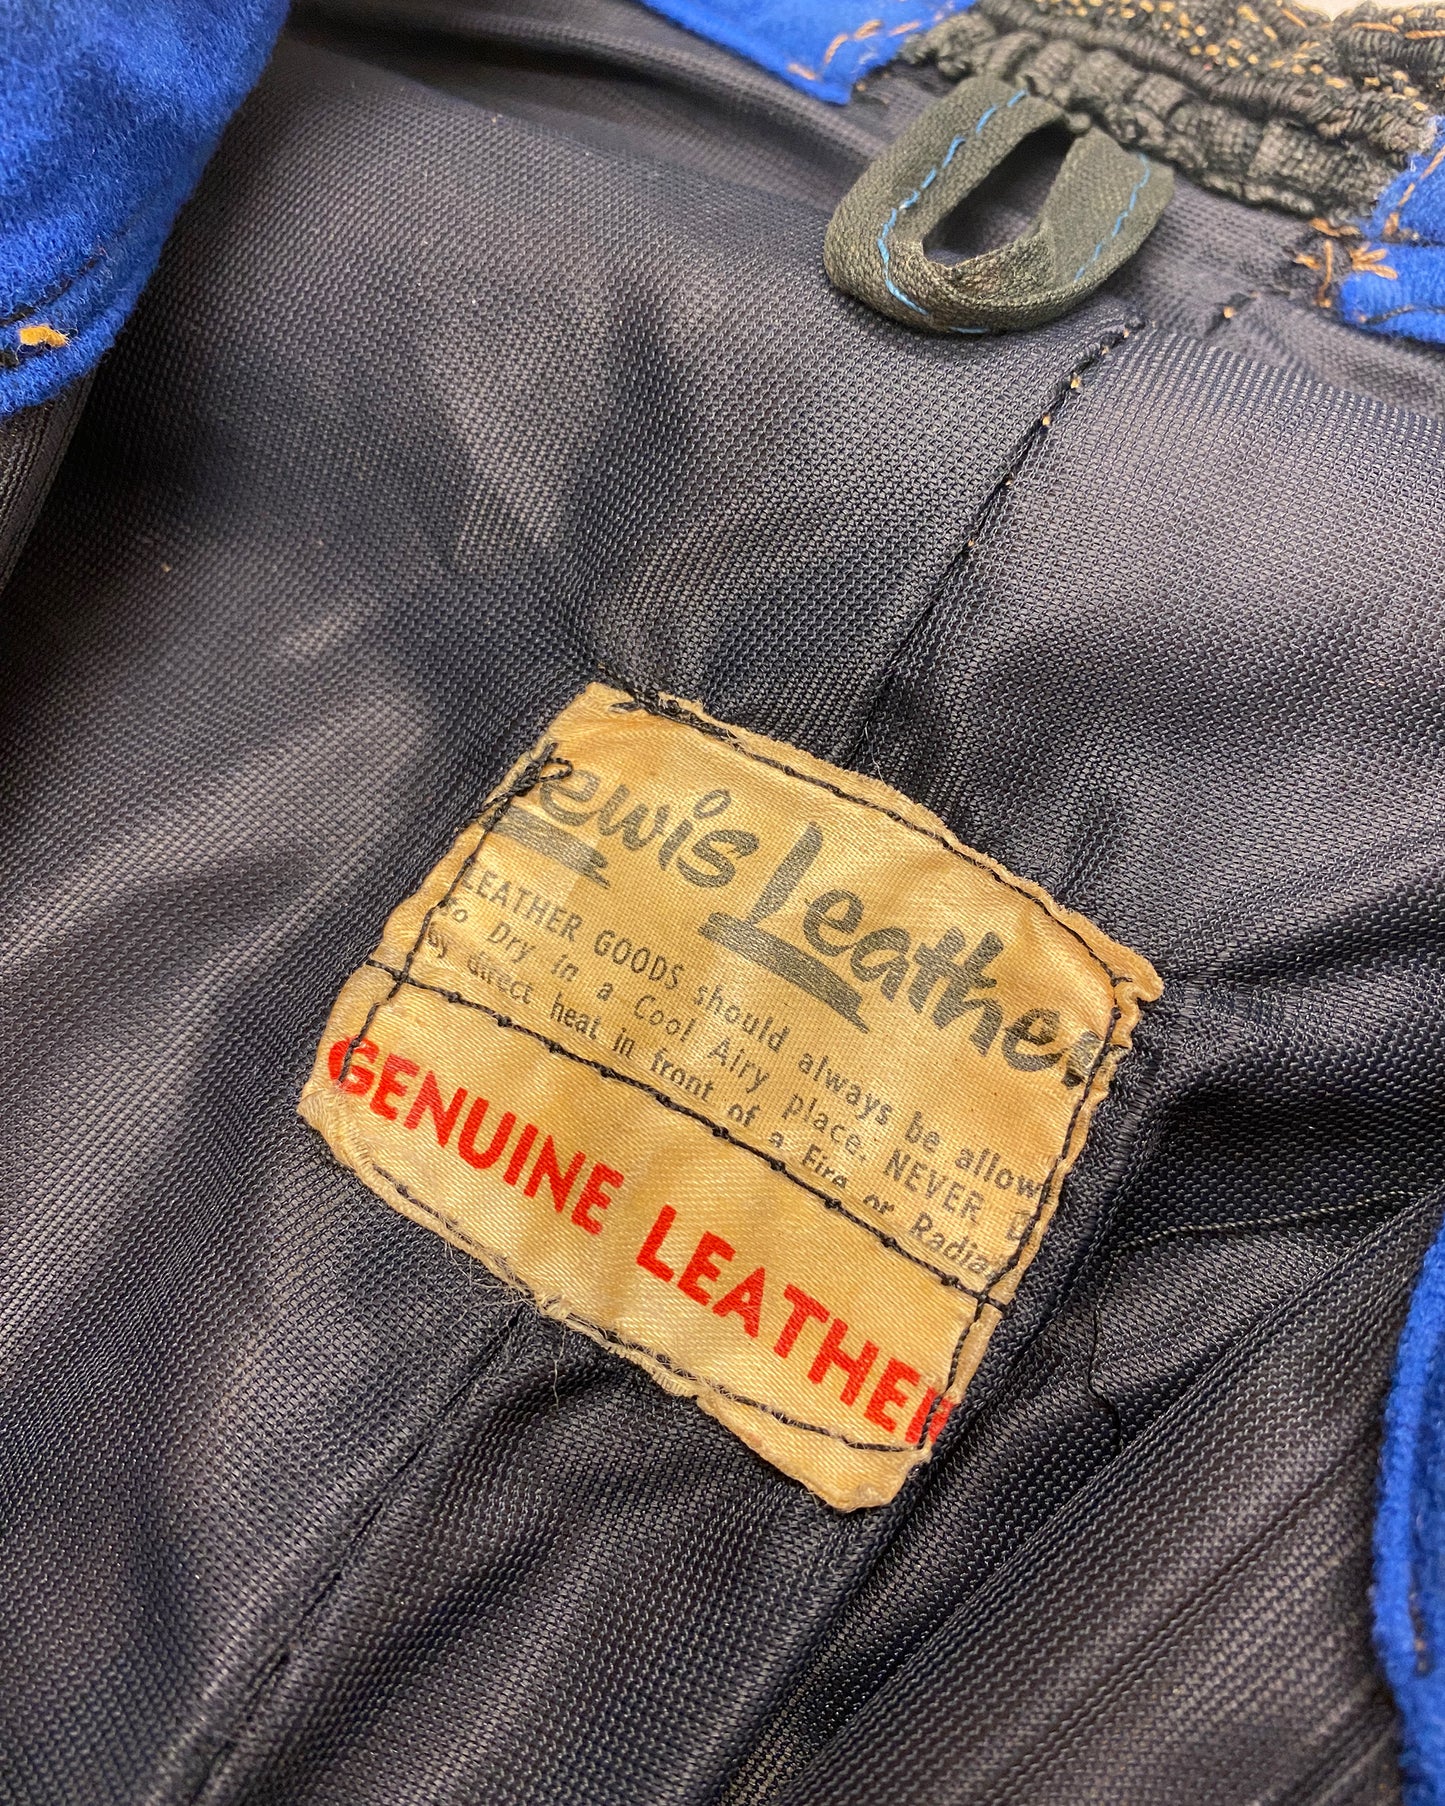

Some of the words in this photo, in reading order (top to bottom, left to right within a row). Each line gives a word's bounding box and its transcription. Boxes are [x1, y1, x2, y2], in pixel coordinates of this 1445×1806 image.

[479, 769, 760, 889] ewis
[461, 866, 583, 942] LEATHER
[593, 929, 685, 990] GOODS
[694, 983, 790, 1052] should
[798, 1052, 893, 1126] always
[904, 1110, 940, 1153] be
[486, 922, 537, 964] Dry
[551, 953, 580, 982] in
[596, 982, 614, 1002] a
[633, 994, 697, 1042] Cool
[707, 1037, 770, 1094] Airy
[883, 1148, 985, 1223] NEVER
[550, 991, 602, 1040] heat
[611, 1027, 636, 1058] in
[650, 1047, 714, 1101] front
[726, 1103, 761, 1127] of
[768, 1130, 785, 1148] a
[327, 1034, 625, 1236] GENUINE
